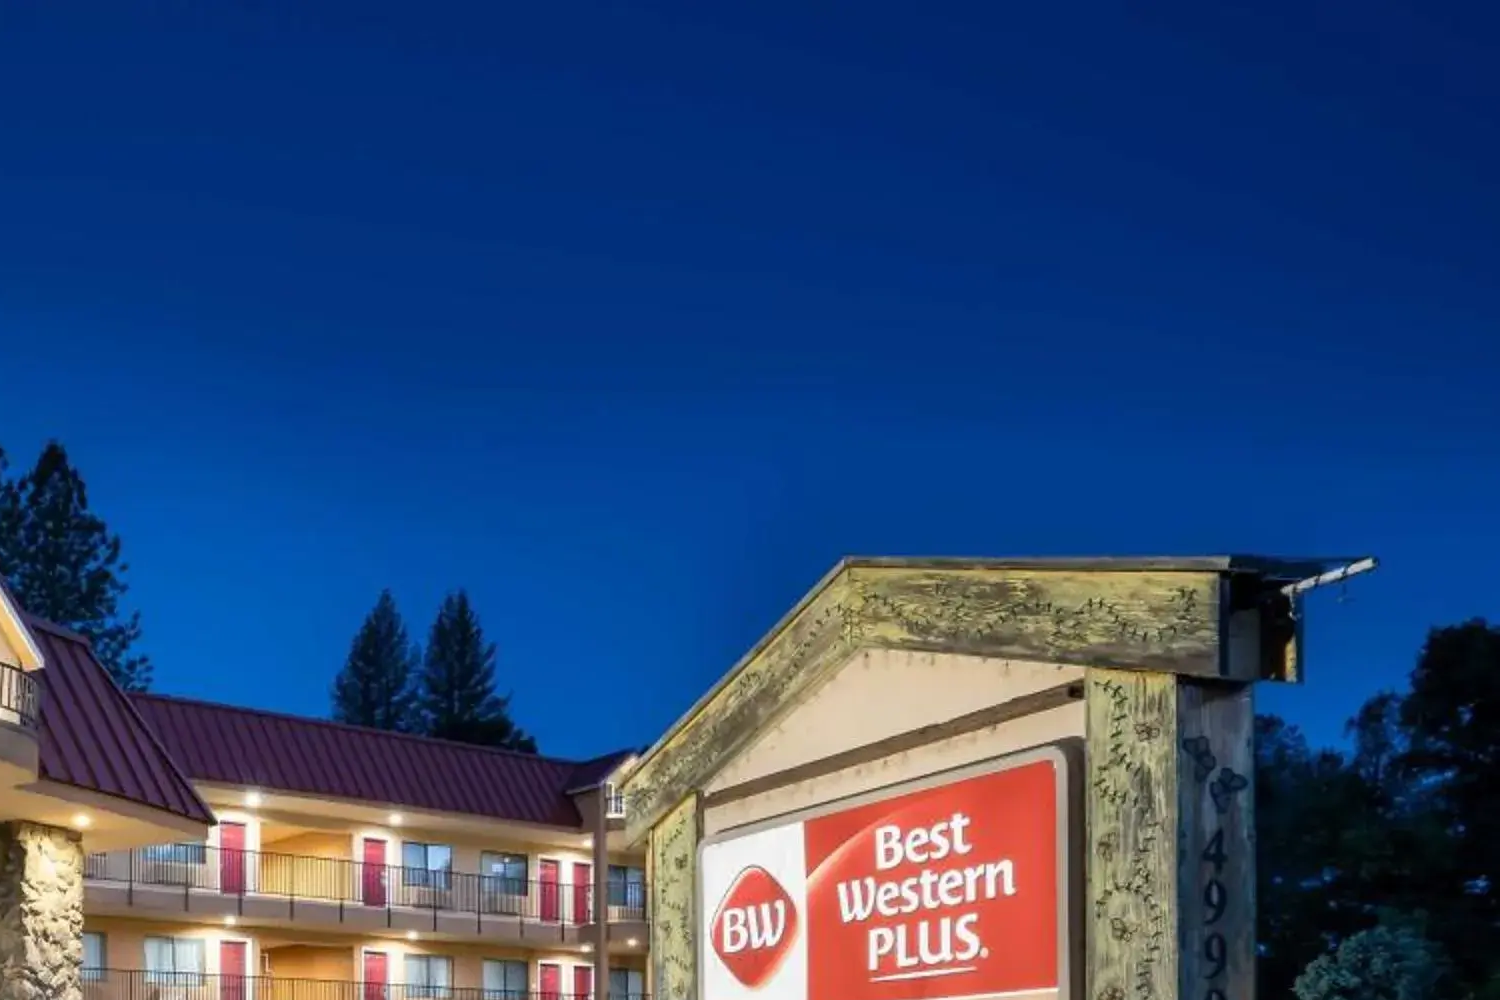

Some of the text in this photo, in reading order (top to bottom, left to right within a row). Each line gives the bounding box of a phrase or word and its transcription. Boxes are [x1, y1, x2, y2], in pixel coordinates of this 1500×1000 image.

[875, 813, 973, 871] Best
[837, 859, 1016, 922] Western
[723, 899, 785, 953] BW
